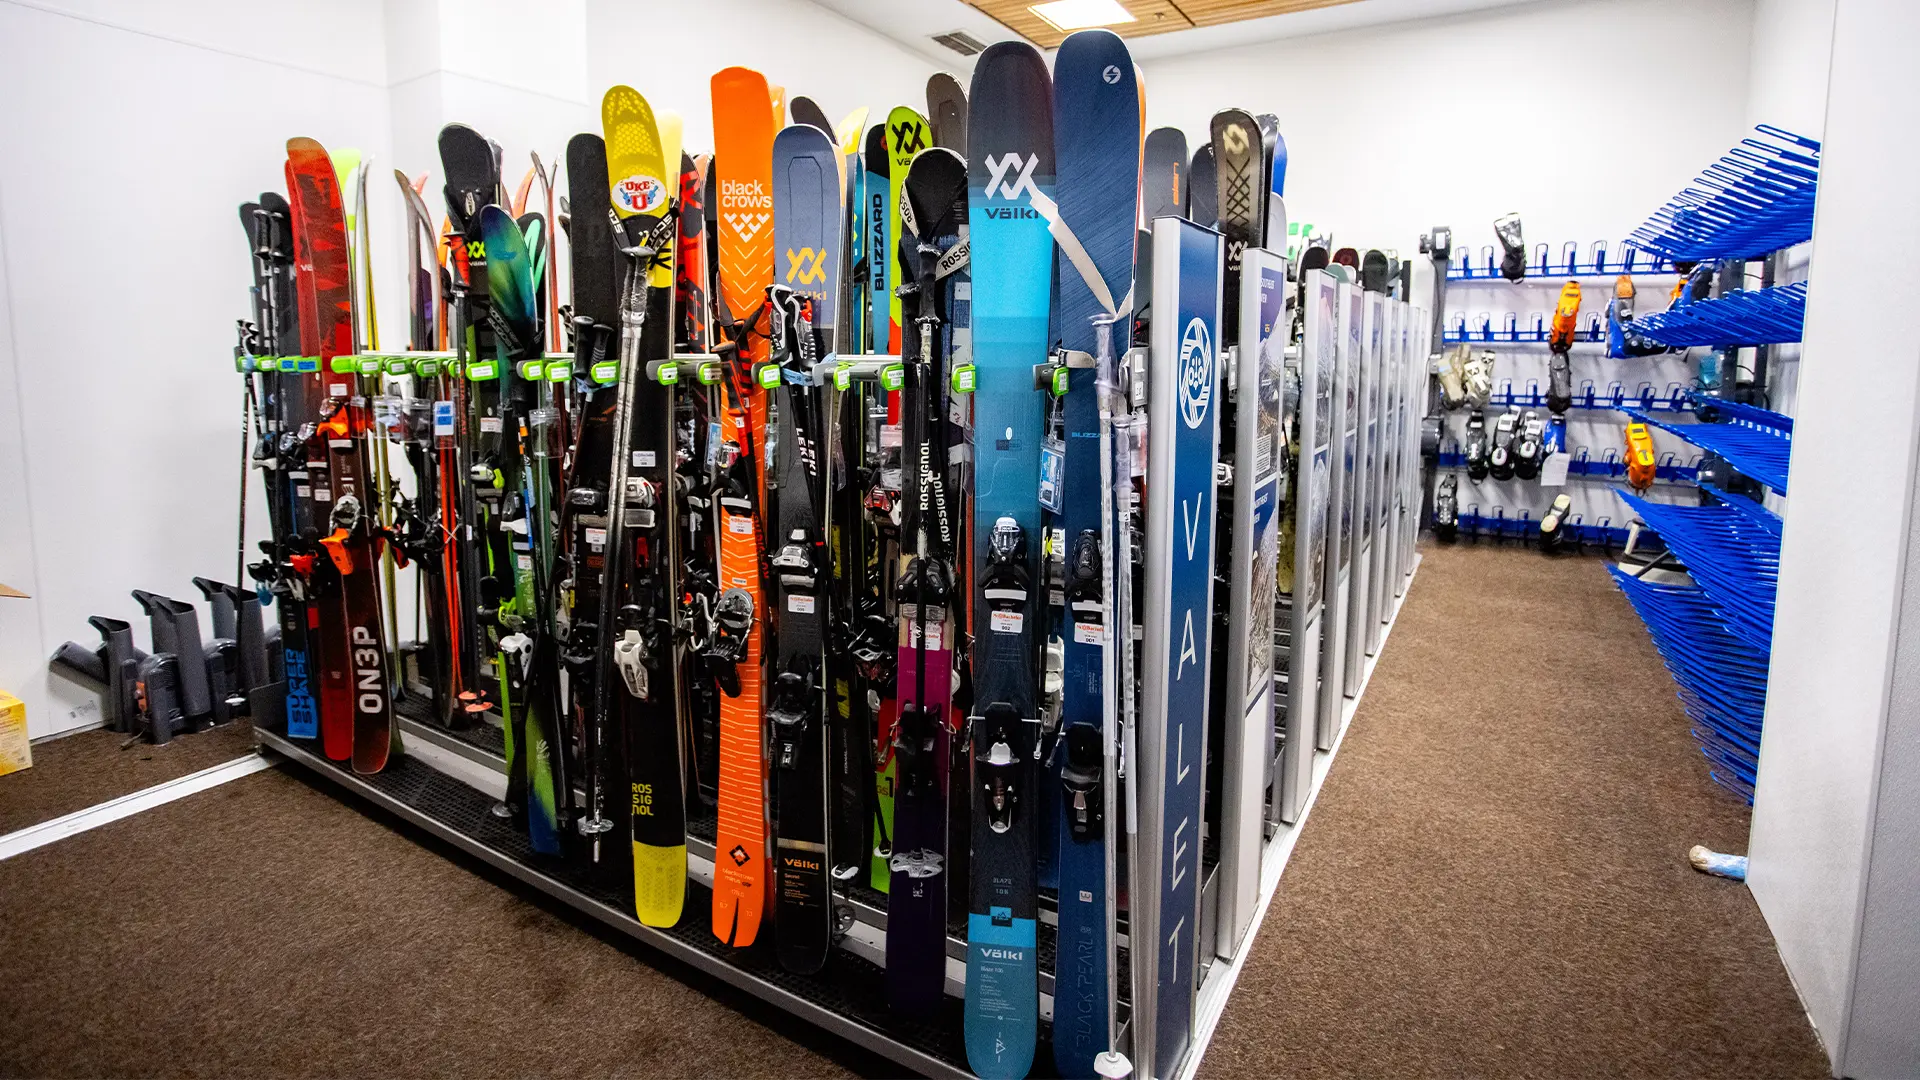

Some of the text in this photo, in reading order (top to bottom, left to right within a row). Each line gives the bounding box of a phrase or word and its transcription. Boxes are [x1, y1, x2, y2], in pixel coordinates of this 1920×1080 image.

[625, 181, 650, 191] UKE
[721, 180, 764, 195] black
[631, 194, 648, 211] U
[722, 195, 773, 208] crows
[984, 207, 1039, 219] Völkl
[873, 193, 885, 291] BLIZZARD
[795, 427, 808, 463] LEKI
[807, 439, 817, 476] LEKI
[919, 438, 930, 511] ROSSIGNOL
[933, 472, 951, 542] ROSSIGNOL
[352, 626, 384, 714] ON3P
[1168, 492, 1202, 985] VALET
[632, 782, 653, 794] ROS
[632, 794, 653, 805] SIG
[784, 857, 820, 870] Völkl
[980, 948, 1023, 961] Völkl
[1077, 938, 1094, 988] PEARL
[1076, 991, 1094, 1047] BLACK
